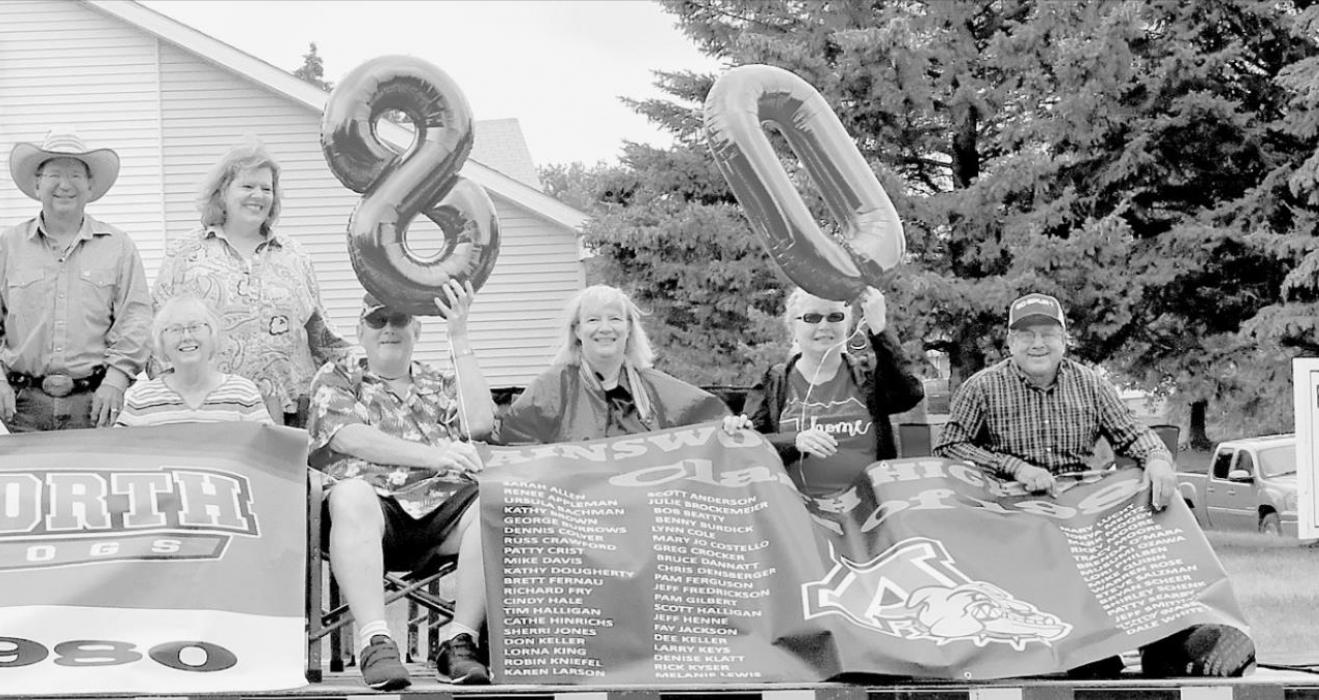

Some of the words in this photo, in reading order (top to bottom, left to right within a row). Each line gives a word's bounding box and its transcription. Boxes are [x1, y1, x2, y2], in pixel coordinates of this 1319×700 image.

[320, 54, 501, 316] 8
[503, 488, 545, 498] RENEE
[549, 486, 586, 500] ALLEN
[503, 497, 556, 510] URSULA
[648, 498, 682, 506] JULIE
[689, 493, 757, 506] ANDERSON
[503, 506, 548, 514] KATHY
[653, 507, 681, 515] BOB
[683, 509, 725, 523] BEATTY
[503, 517, 559, 525] GEORGE
[655, 516, 697, 527] BENNY
[700, 521, 755, 533] BURDICK
[651, 525, 684, 534] LYNN
[687, 528, 716, 539] COLE
[1107, 518, 1154, 543] MOORE
[1114, 524, 1162, 546] MOORE
[542, 537, 617, 551] CRAWFORD
[652, 535, 690, 544] MARY
[693, 538, 708, 546] JO
[710, 540, 770, 552] COSTELLO
[503, 547, 545, 555] PATTY
[547, 547, 585, 555] CRIST
[653, 544, 687, 554] GREG
[690, 547, 745, 561] CROCKER
[503, 557, 539, 565] MIKE
[542, 557, 583, 565] DAVIS
[656, 554, 698, 565] BRUCE
[701, 557, 760, 570] DANNATT
[1150, 558, 1183, 570] ROSE
[503, 567, 548, 575] KATHY
[550, 567, 636, 578] DOUGHERTY
[657, 564, 693, 574] CHRIS
[1083, 567, 1113, 582] LORI
[503, 577, 547, 585] BRETT
[549, 577, 604, 586] FERNAU
[654, 573, 683, 583] PAM
[685, 576, 754, 590] FERGUSON
[1087, 571, 1121, 588] MIKE
[503, 587, 565, 595] RICHARD
[568, 588, 593, 596] FRY
[654, 583, 679, 592] JEFF
[682, 586, 771, 599] FREDRICKSON
[503, 597, 546, 605] CINDY
[548, 597, 583, 605] HALE
[654, 593, 683, 602] PAM
[686, 596, 738, 606] GILBERT
[503, 607, 530, 615] TIM
[532, 607, 602, 616] HALLIGAN
[654, 603, 694, 613] SCOTT
[696, 607, 763, 617] HALLIGAN
[503, 617, 546, 626] CATHE
[549, 617, 615, 627] HINRICHS
[654, 614, 680, 622] JEFF
[683, 616, 729, 625] HENNE
[554, 628, 597, 636] JONES
[654, 624, 676, 632] FAY
[678, 626, 739, 636] JACKSON
[503, 637, 535, 645] DON
[539, 637, 586, 645] KELLER
[654, 634, 679, 642] DEE
[682, 635, 728, 644] KELLER
[503, 648, 550, 656] LORNA
[553, 647, 587, 656] KING
[654, 644, 695, 653] LARRY
[698, 646, 731, 654] KEYS
[504, 658, 547, 666] ROBIN
[550, 658, 604, 667] KNIEFEL
[654, 654, 701, 662] DENISE
[504, 668, 549, 676] KAREN
[552, 667, 606, 677] LARSON
[654, 663, 685, 671] RICK
